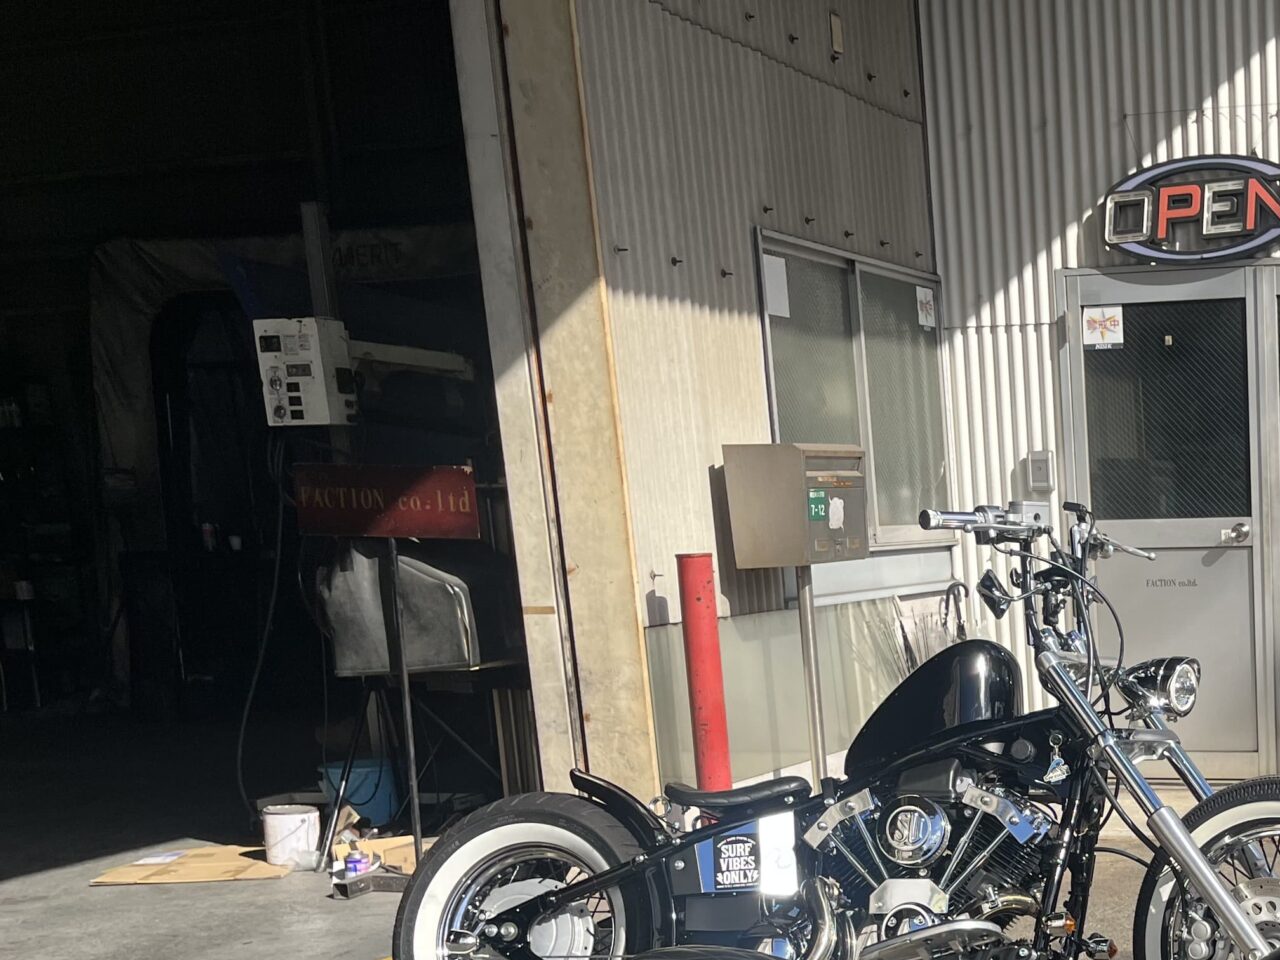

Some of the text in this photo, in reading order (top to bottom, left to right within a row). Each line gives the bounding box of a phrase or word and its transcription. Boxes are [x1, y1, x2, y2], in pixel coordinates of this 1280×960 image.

[299, 487, 385, 510] FACTION
[1146, 578, 1177, 588] FACTION
[720, 843, 753, 858] SURF
[719, 856, 756, 872] VIBES
[723, 869, 754, 885] ONLY
